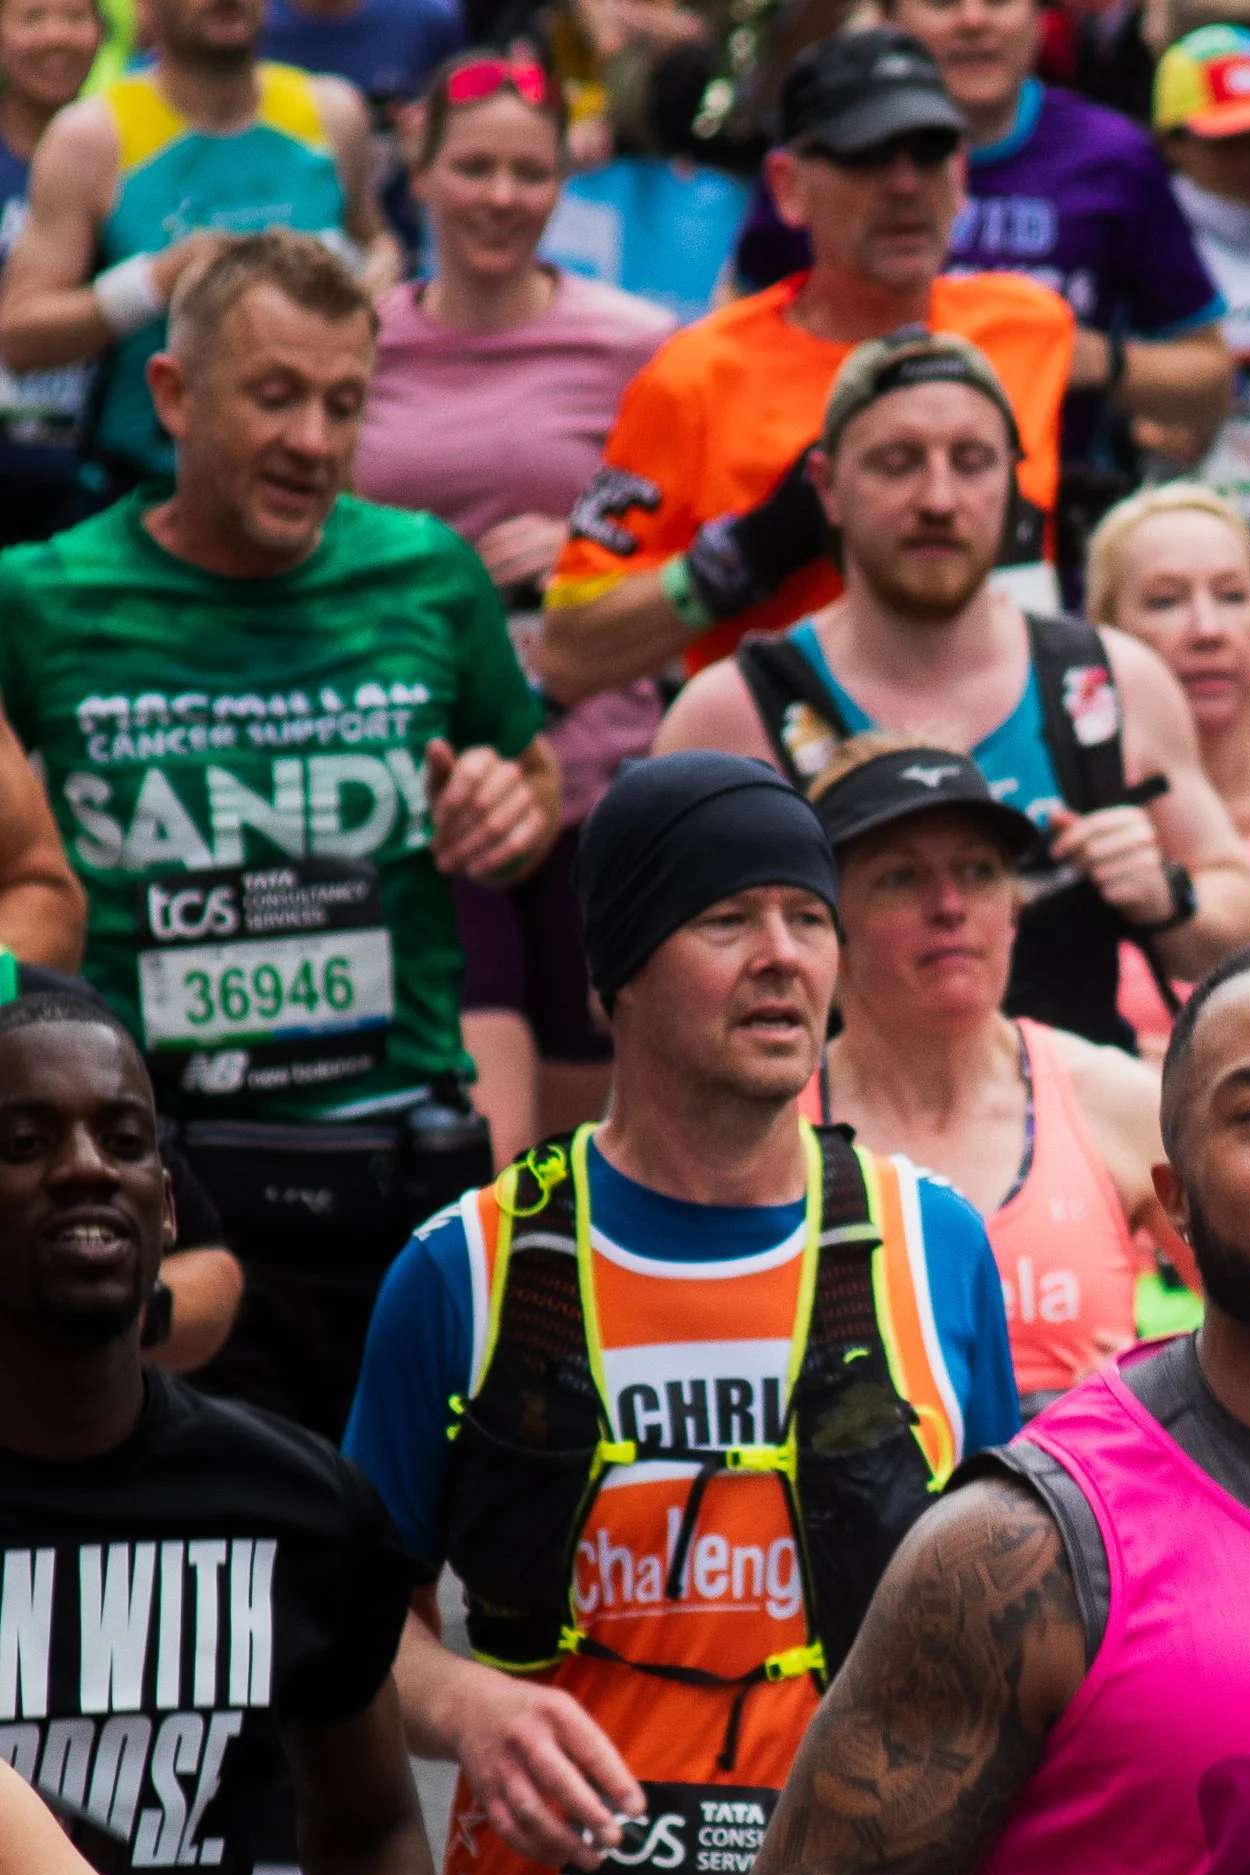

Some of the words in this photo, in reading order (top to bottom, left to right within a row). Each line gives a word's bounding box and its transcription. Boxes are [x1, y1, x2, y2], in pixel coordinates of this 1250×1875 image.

[86, 725, 237, 763] CANCER
[246, 709, 412, 747] SUPPORT
[63, 748, 432, 871] SANDY
[243, 868, 297, 889] TATA
[183, 955, 354, 1027] 36946
[79, 1538, 278, 1715] WITH
[701, 1802, 766, 1825] TATA
